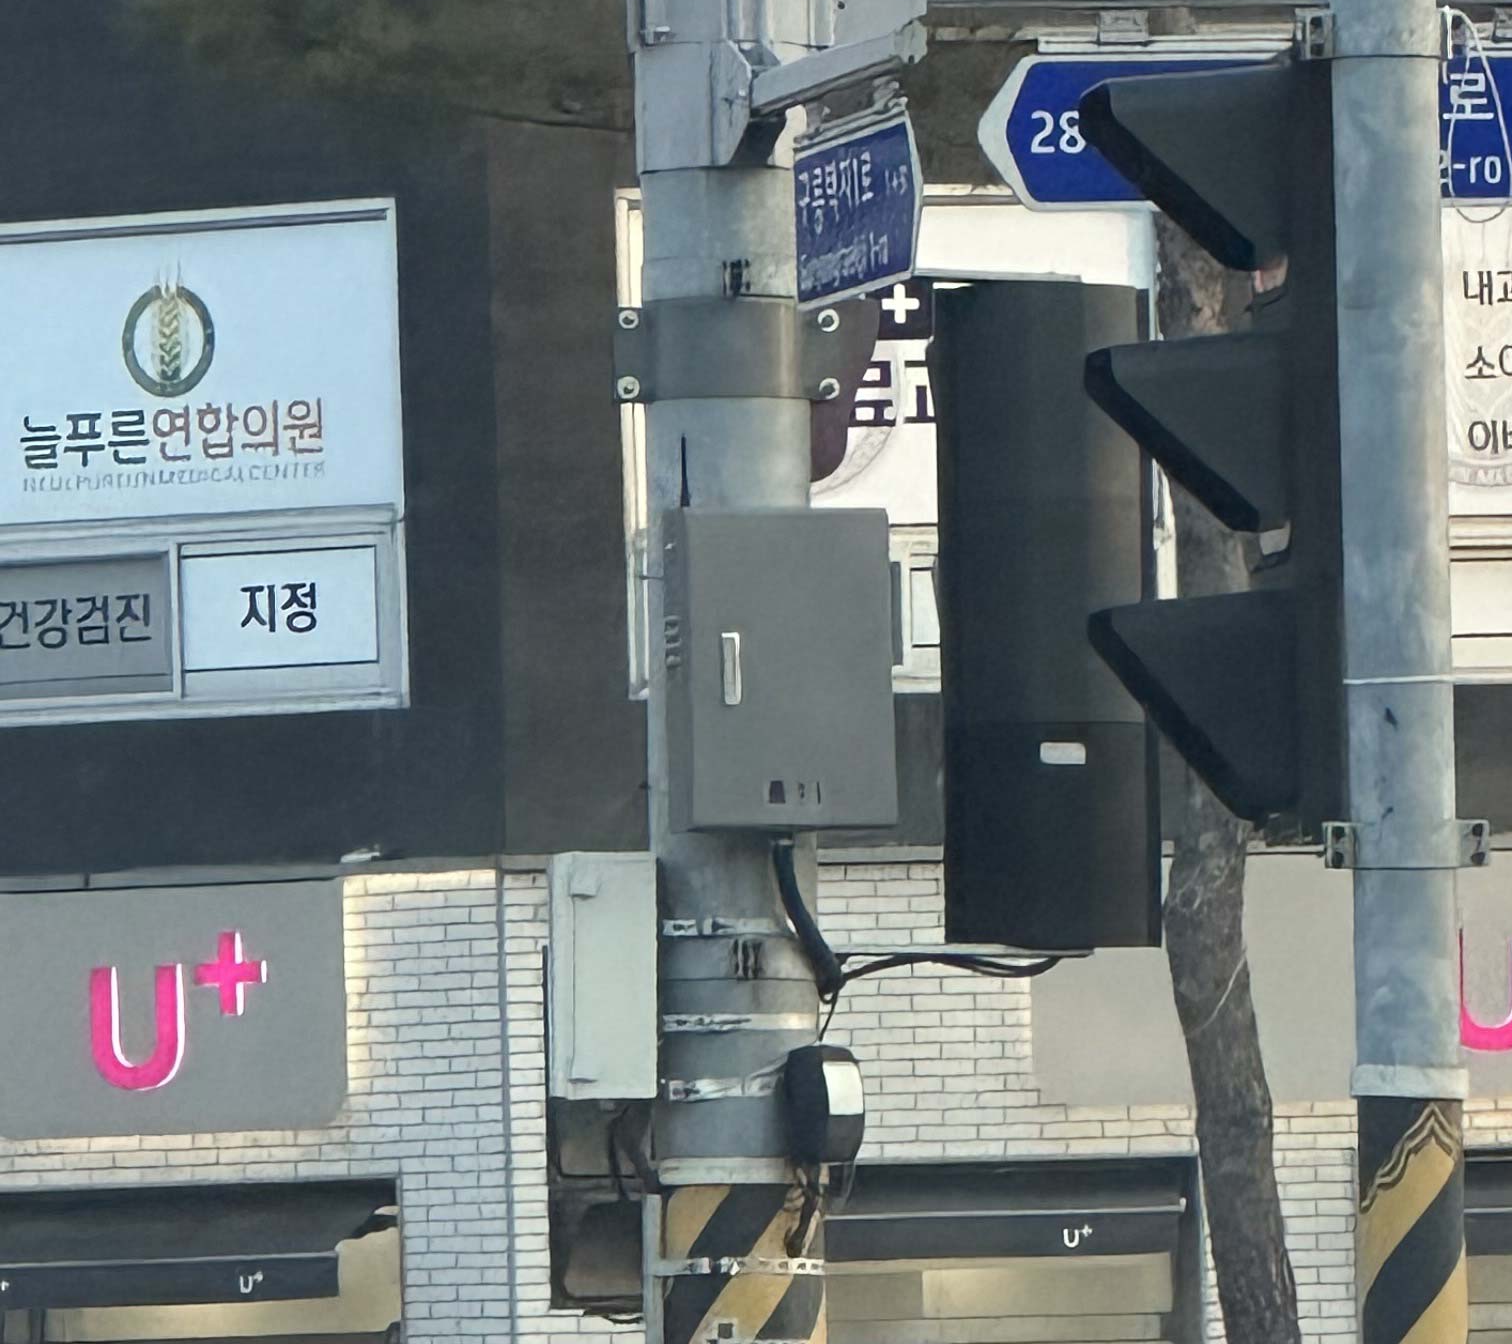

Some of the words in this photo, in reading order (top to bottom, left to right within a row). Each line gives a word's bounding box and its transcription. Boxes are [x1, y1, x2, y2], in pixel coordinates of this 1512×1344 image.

[1443, 61, 1494, 119] 로
[1030, 110, 1087, 155] 28
[20, 397, 323, 469] 늘푸른연합의원
[0, 593, 153, 651] 건강검진
[240, 581, 318, 633] 지정
[89, 930, 268, 1091] U+
[1063, 1224, 1092, 1247] U+
